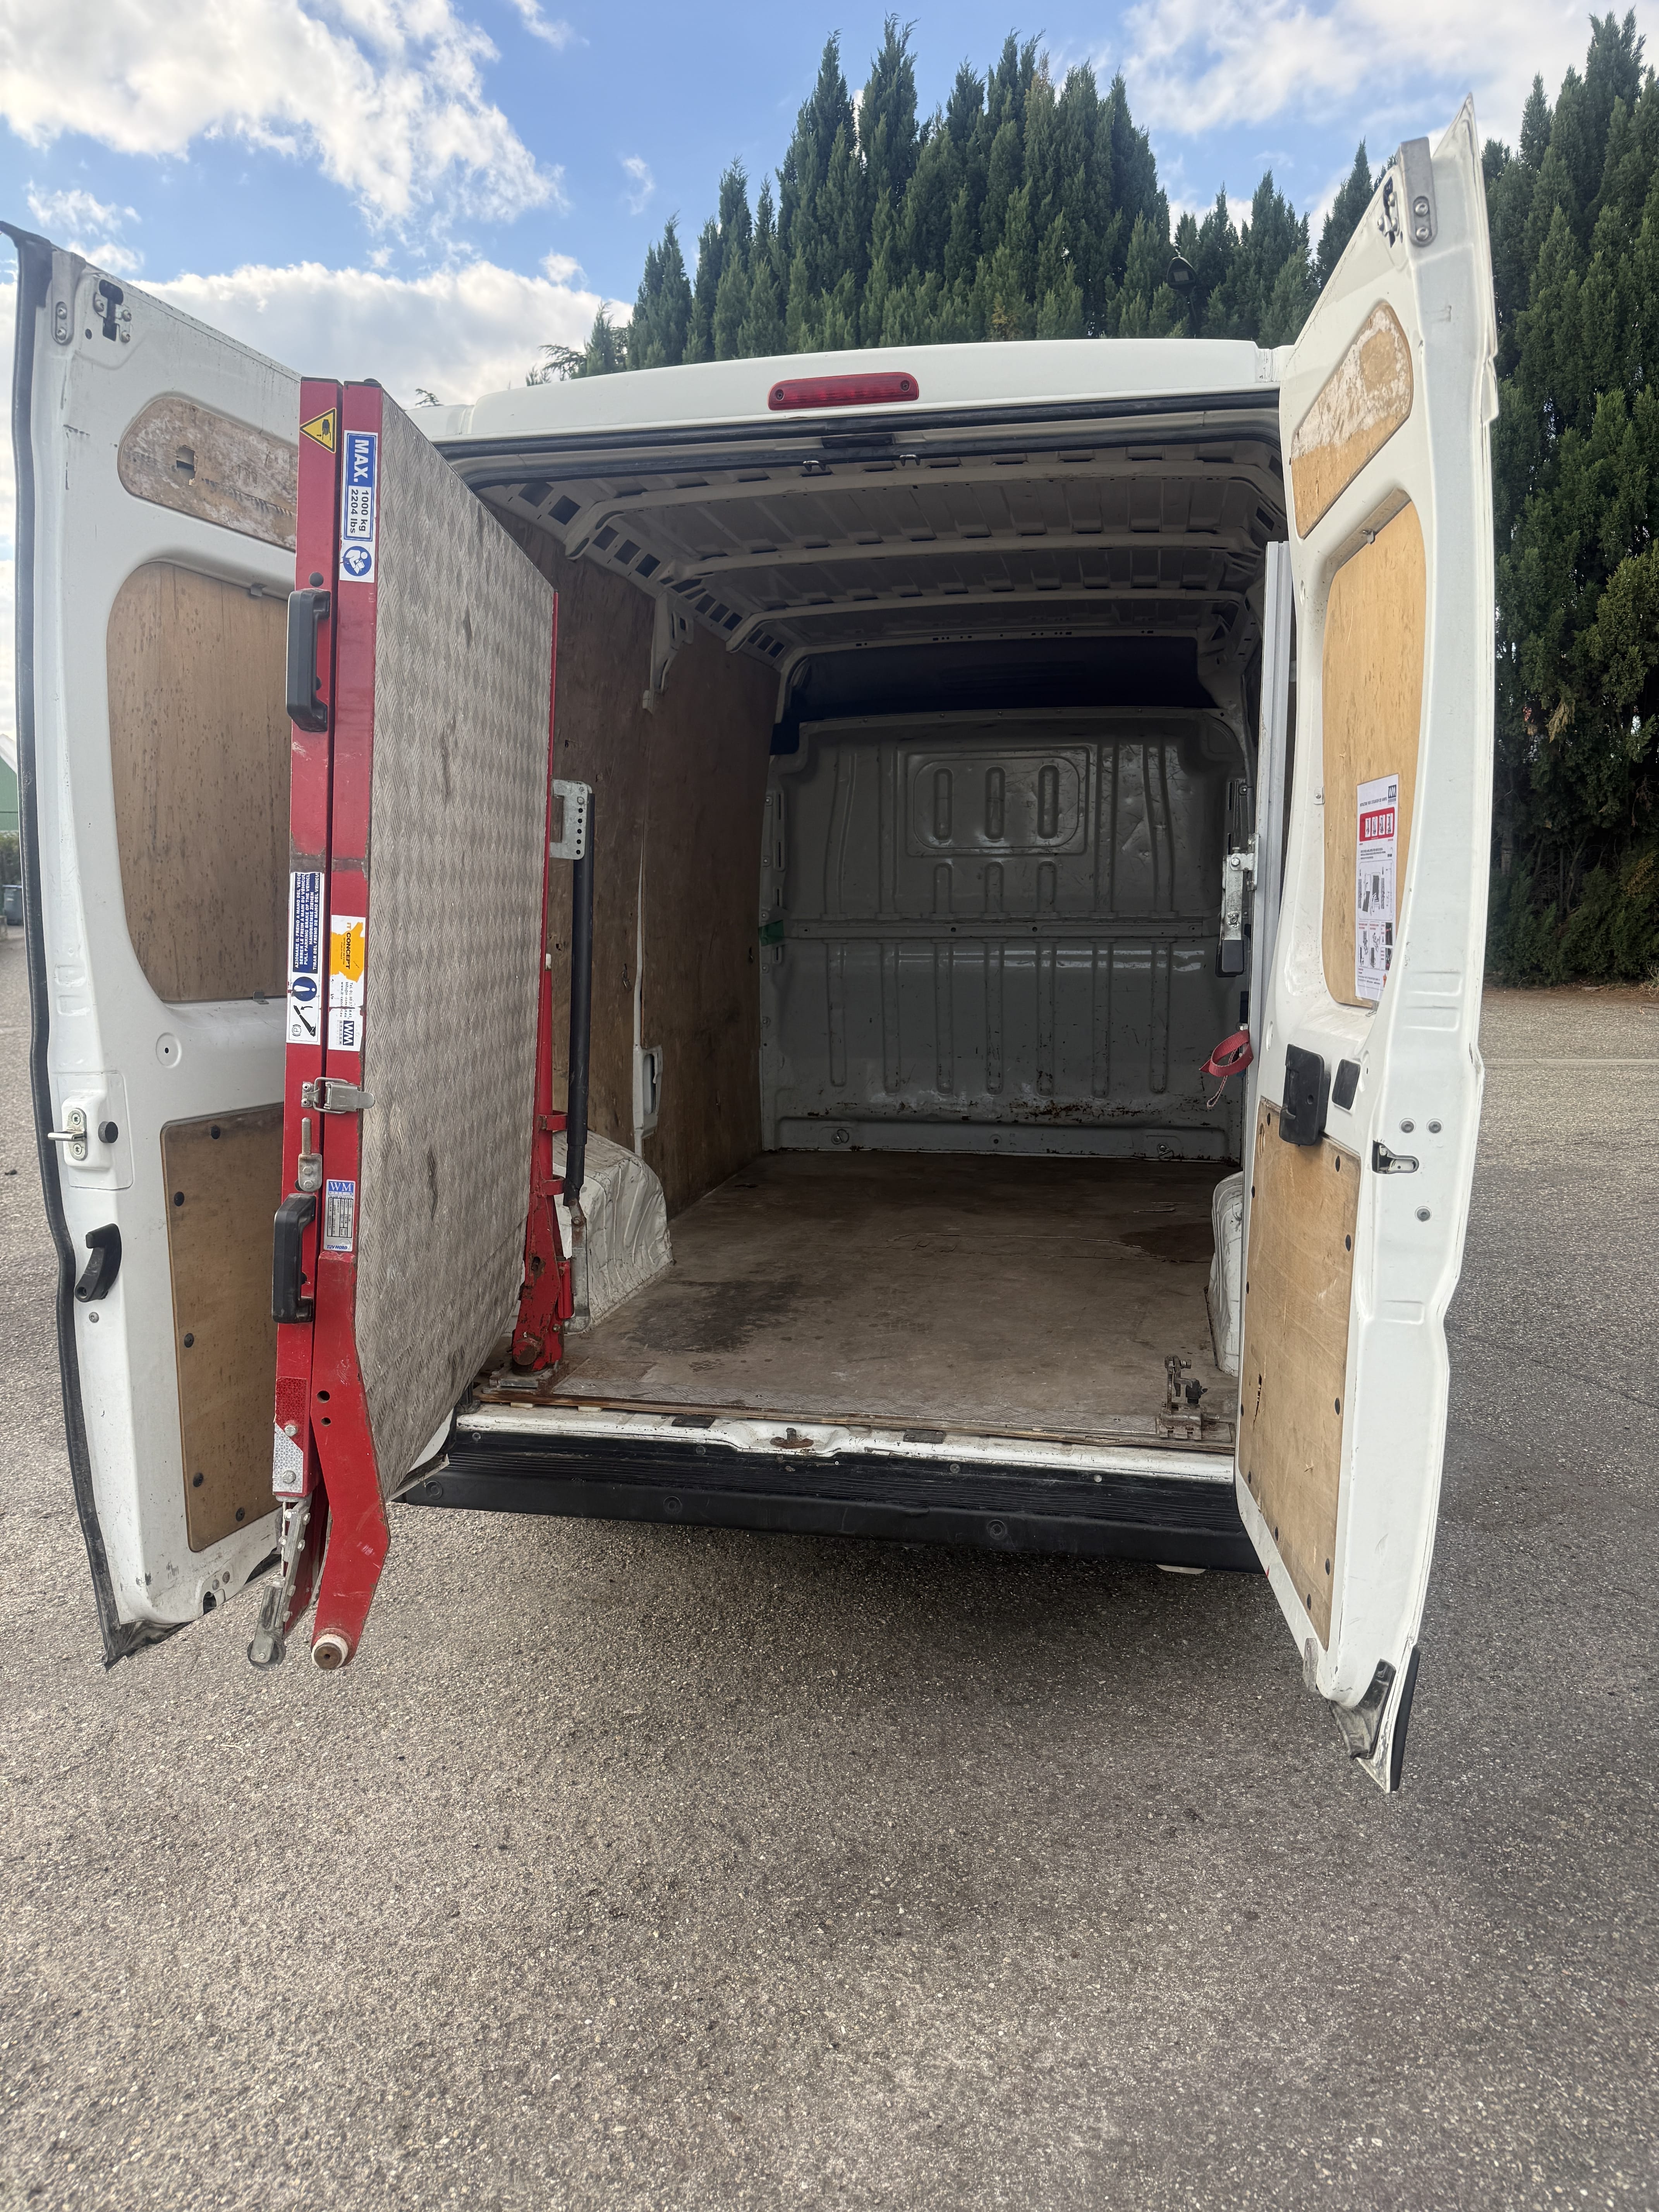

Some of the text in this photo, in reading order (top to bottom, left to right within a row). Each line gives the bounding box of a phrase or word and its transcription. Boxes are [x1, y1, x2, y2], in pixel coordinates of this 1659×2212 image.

[354, 439, 369, 483] MAX.
[359, 519, 367, 532] kg
[344, 1022, 354, 1044] WM
[330, 1182, 352, 1192] WM
